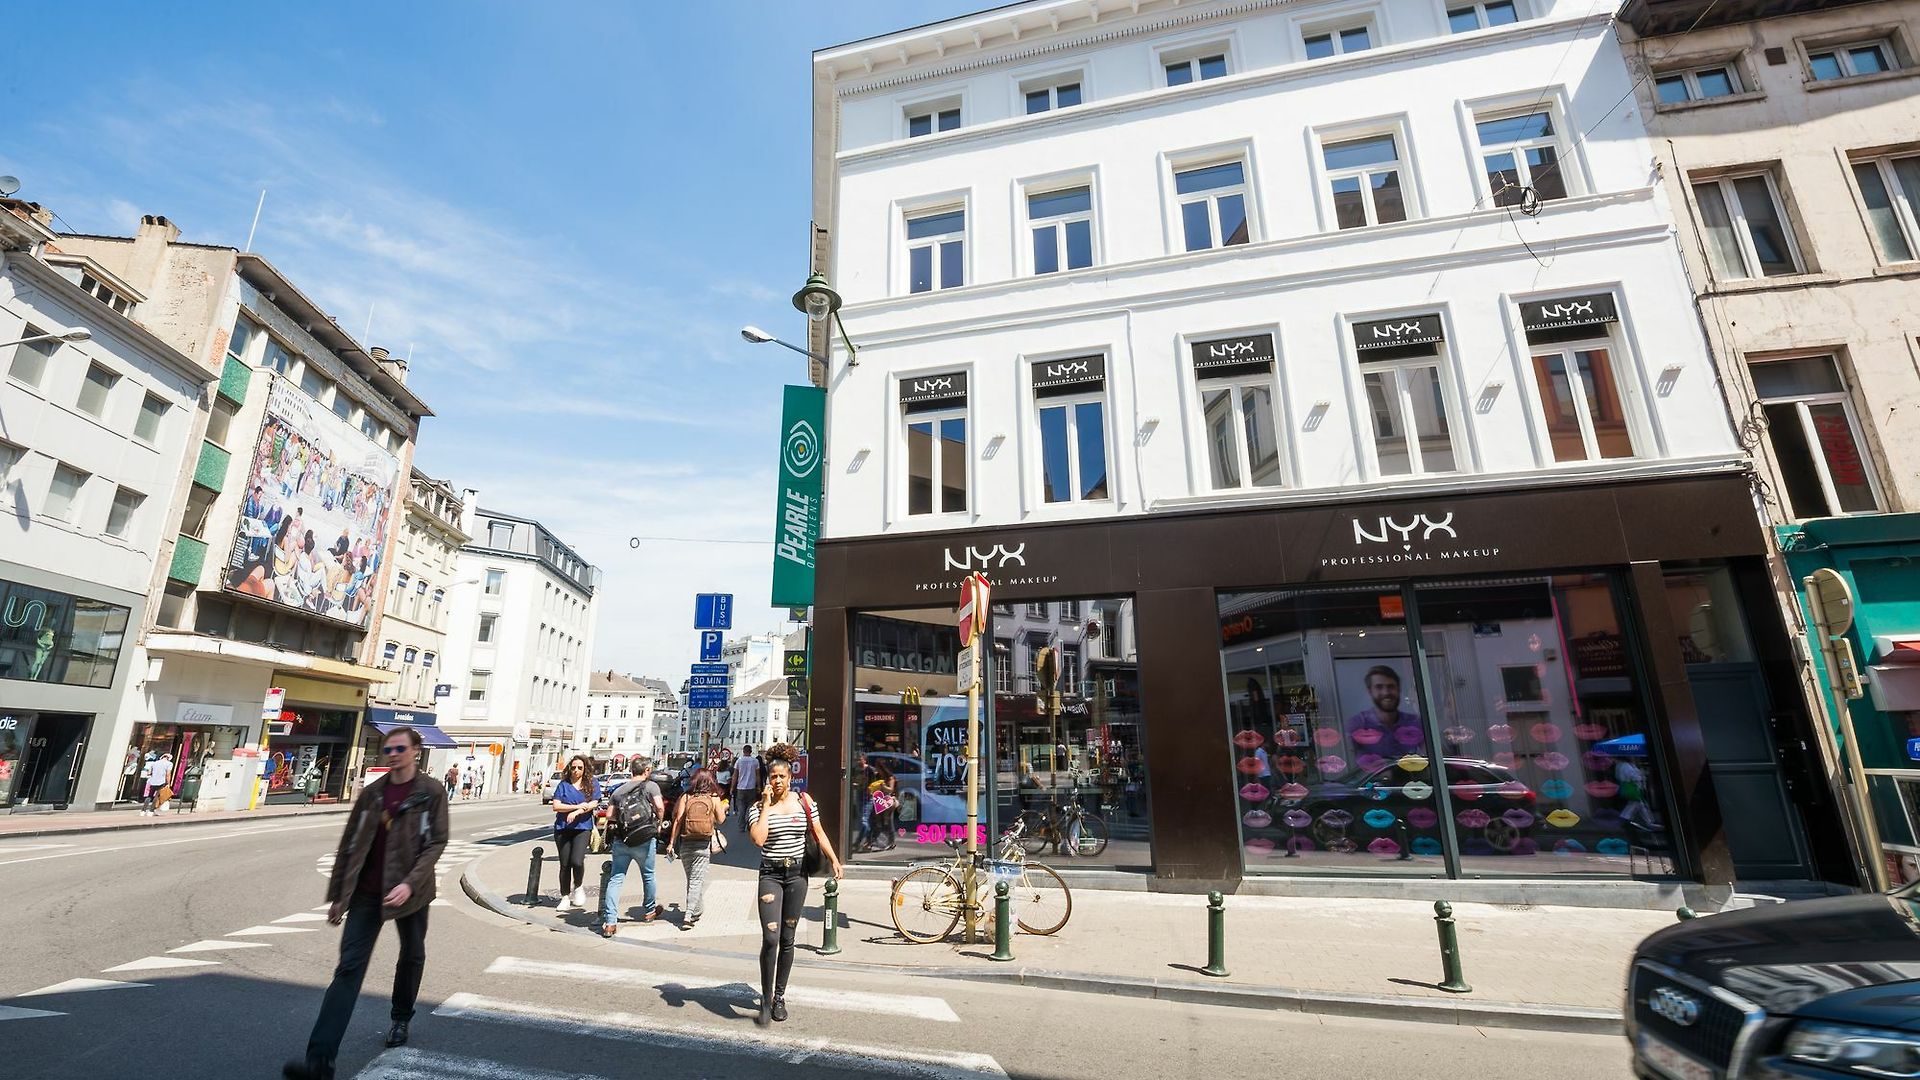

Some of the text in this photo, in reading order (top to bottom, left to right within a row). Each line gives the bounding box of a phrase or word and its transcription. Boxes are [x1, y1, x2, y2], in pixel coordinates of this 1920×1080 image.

[1541, 300, 1593, 318] NYX
[1373, 321, 1421, 338] NYX
[1526, 315, 1614, 329] PROFESSIONAL MAKEUP
[1210, 341, 1254, 357] NYX
[1359, 339, 1409, 348] PROFESSIONAL
[1047, 360, 1088, 377] NYX
[1196, 358, 1242, 367] PROFESSIONAL
[914, 377, 951, 392] NYX
[1034, 378, 1076, 387] PROFESSIONAL
[777, 488, 809, 566] PEARLE
[806, 497, 818, 569] OPTICIENS
[1352, 512, 1457, 544] NYX
[944, 542, 1026, 571] NYX
[1322, 548, 1500, 566] PROFESSIONAL MAKEUP
[915, 575, 1058, 590] PROFESSAL MAKEUP
[719, 596, 727, 619] BUS
[705, 634, 717, 650] P
[693, 677, 722, 685] 30 MIN
[183, 708, 213, 722] Etam
[934, 727, 969, 745] SALE
